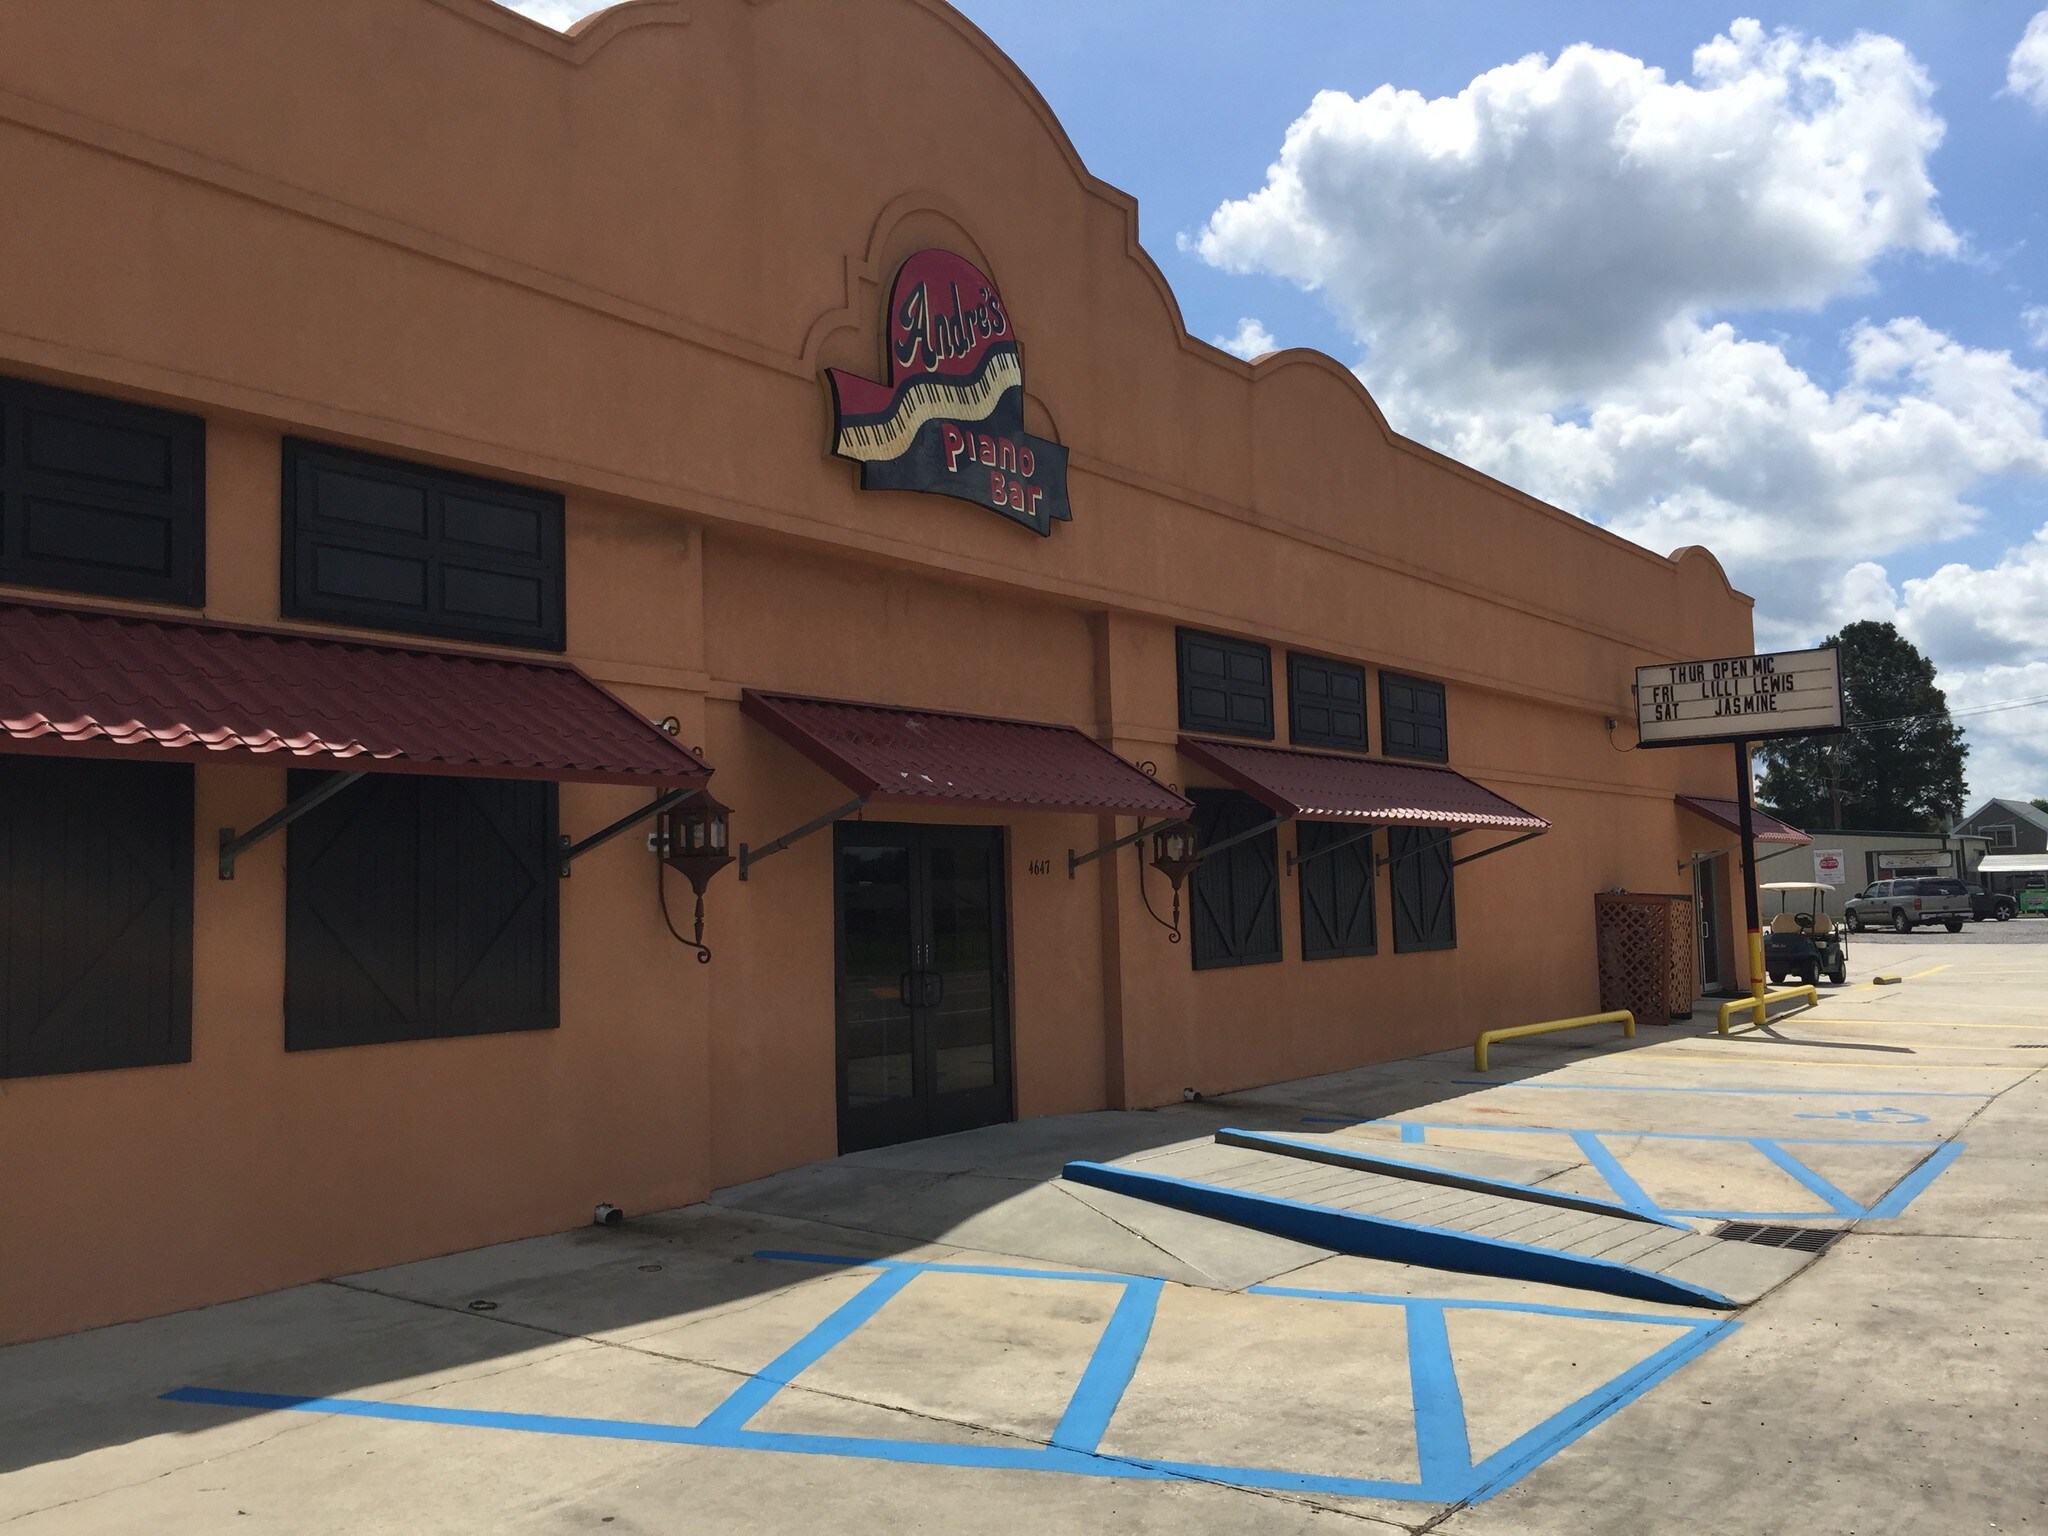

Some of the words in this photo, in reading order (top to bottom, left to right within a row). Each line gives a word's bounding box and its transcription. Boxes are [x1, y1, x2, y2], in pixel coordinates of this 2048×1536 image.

[942, 423, 1035, 478] Piano
[990, 470, 1043, 516] Bar
[1669, 664, 1705, 685] THUR
[1712, 660, 1748, 680] OPEN
[1752, 657, 1775, 676] MIC
[1653, 685, 1675, 703] FRI
[1701, 679, 1739, 699] LILLI
[1752, 674, 1794, 695] LEWIS
[1655, 702, 1680, 721] SAT
[1714, 694, 1778, 716] JASMINE
[1028, 859, 1050, 876] 4647
